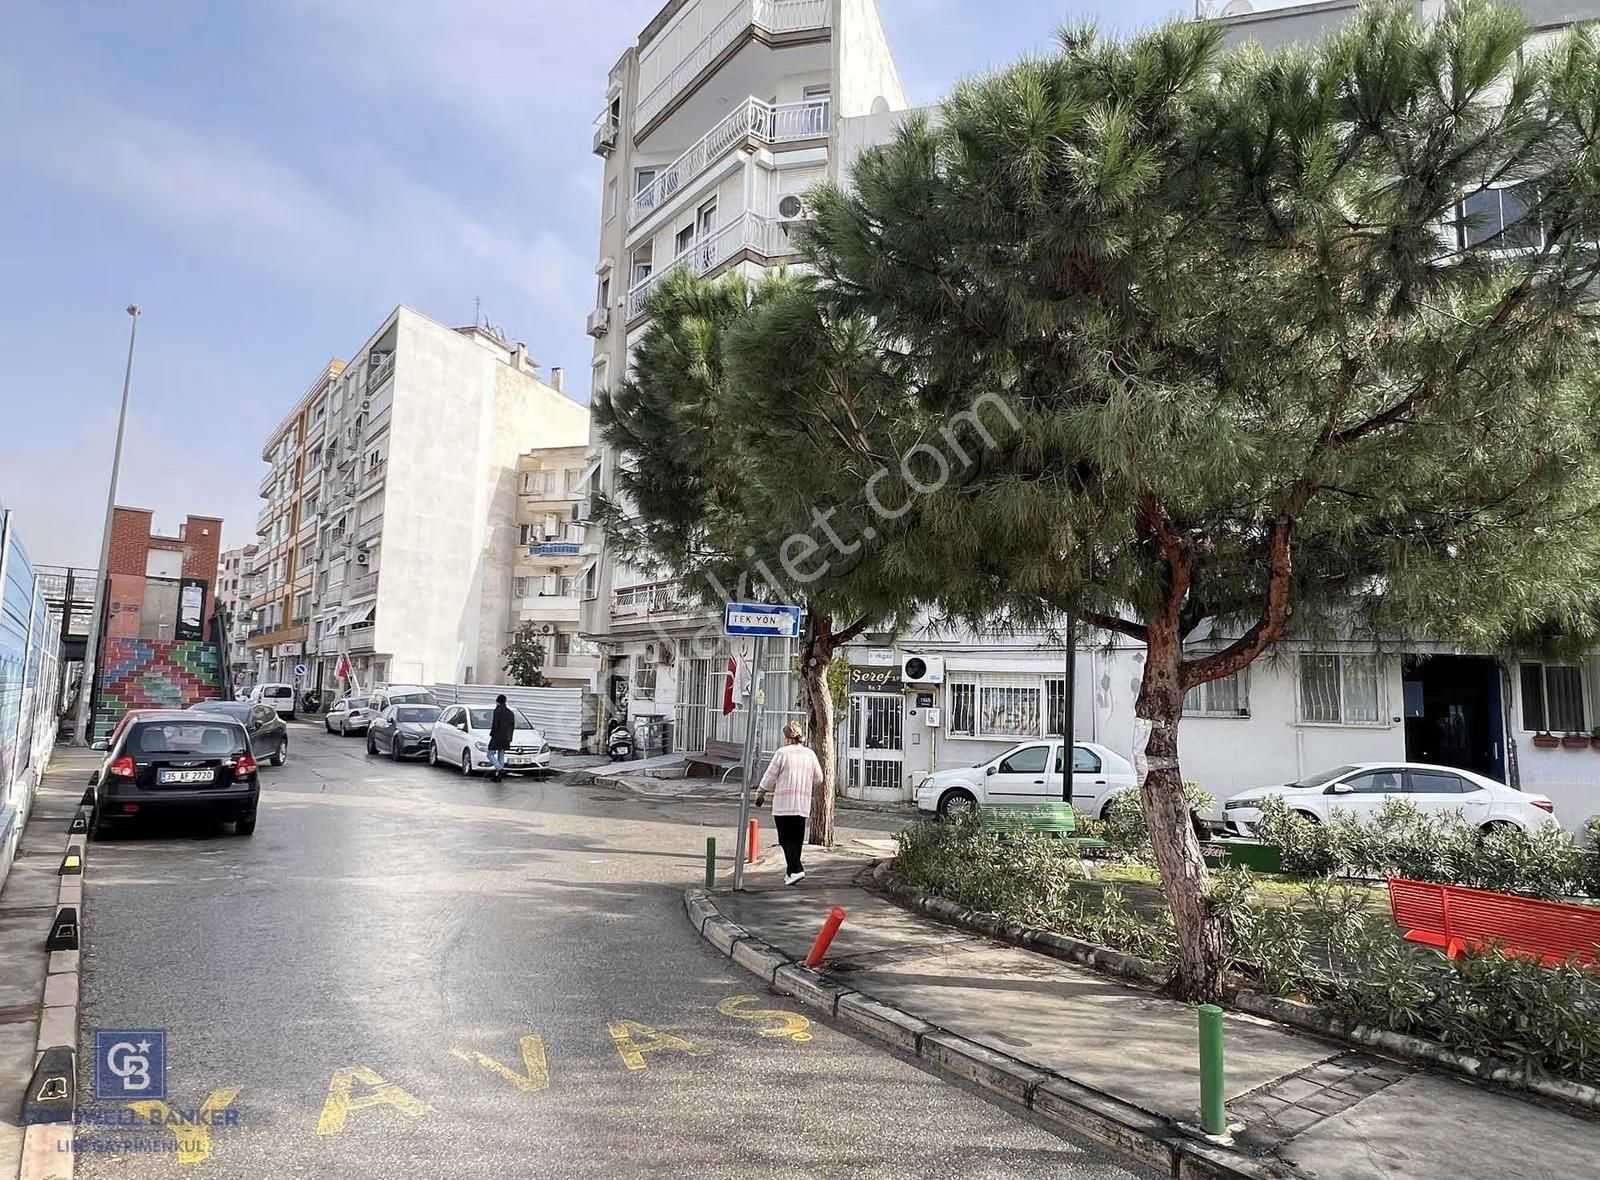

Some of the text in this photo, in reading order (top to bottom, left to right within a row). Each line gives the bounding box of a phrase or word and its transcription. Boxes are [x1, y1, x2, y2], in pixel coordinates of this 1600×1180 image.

[733, 615, 752, 623] TEK
[852, 669, 893, 684] Şeref
[166, 771, 213, 780] 35 AF 2720
[127, 994, 813, 1164] YAVAŞ
